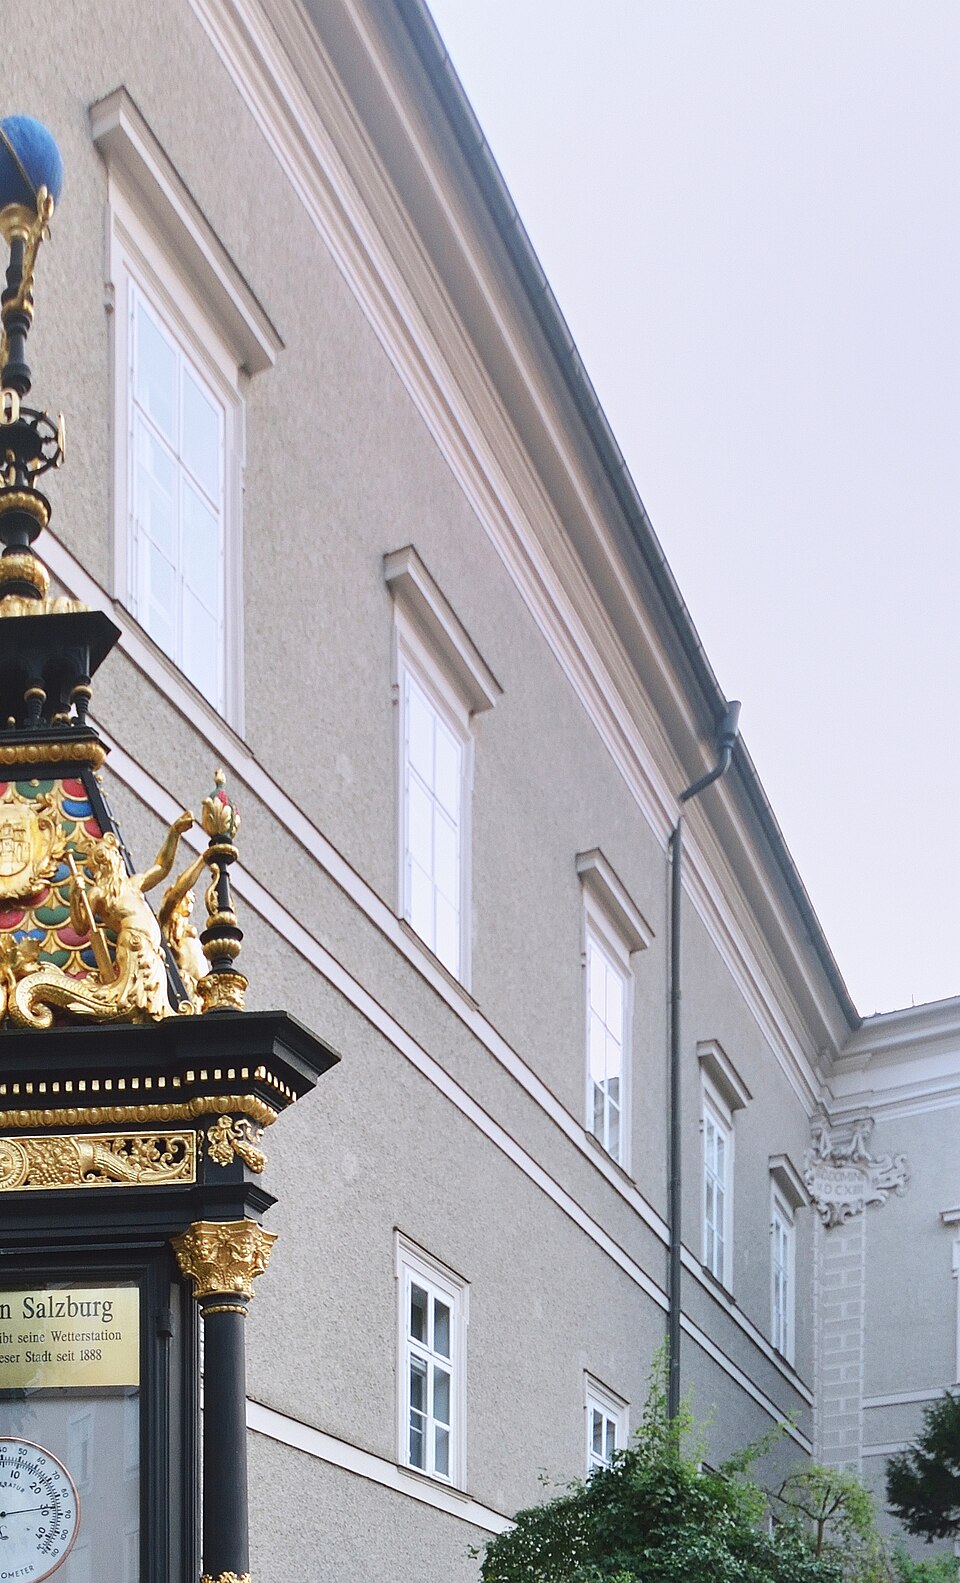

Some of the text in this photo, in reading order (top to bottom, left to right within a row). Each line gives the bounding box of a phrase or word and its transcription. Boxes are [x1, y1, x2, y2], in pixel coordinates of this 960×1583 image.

[22, 1296, 113, 1323] Salzburg
[18, 1331, 45, 1344] seine
[50, 1329, 122, 1343] Wetterstation
[25, 1350, 52, 1363] Stadt
[56, 1350, 75, 1362] seit
[18, 1448, 28, 1456] 50
[10, 1470, 20, 1479] 10
[52, 1470, 60, 1480] 70
[29, 1482, 41, 1494] 20
[35, 1527, 46, 1539] 40
